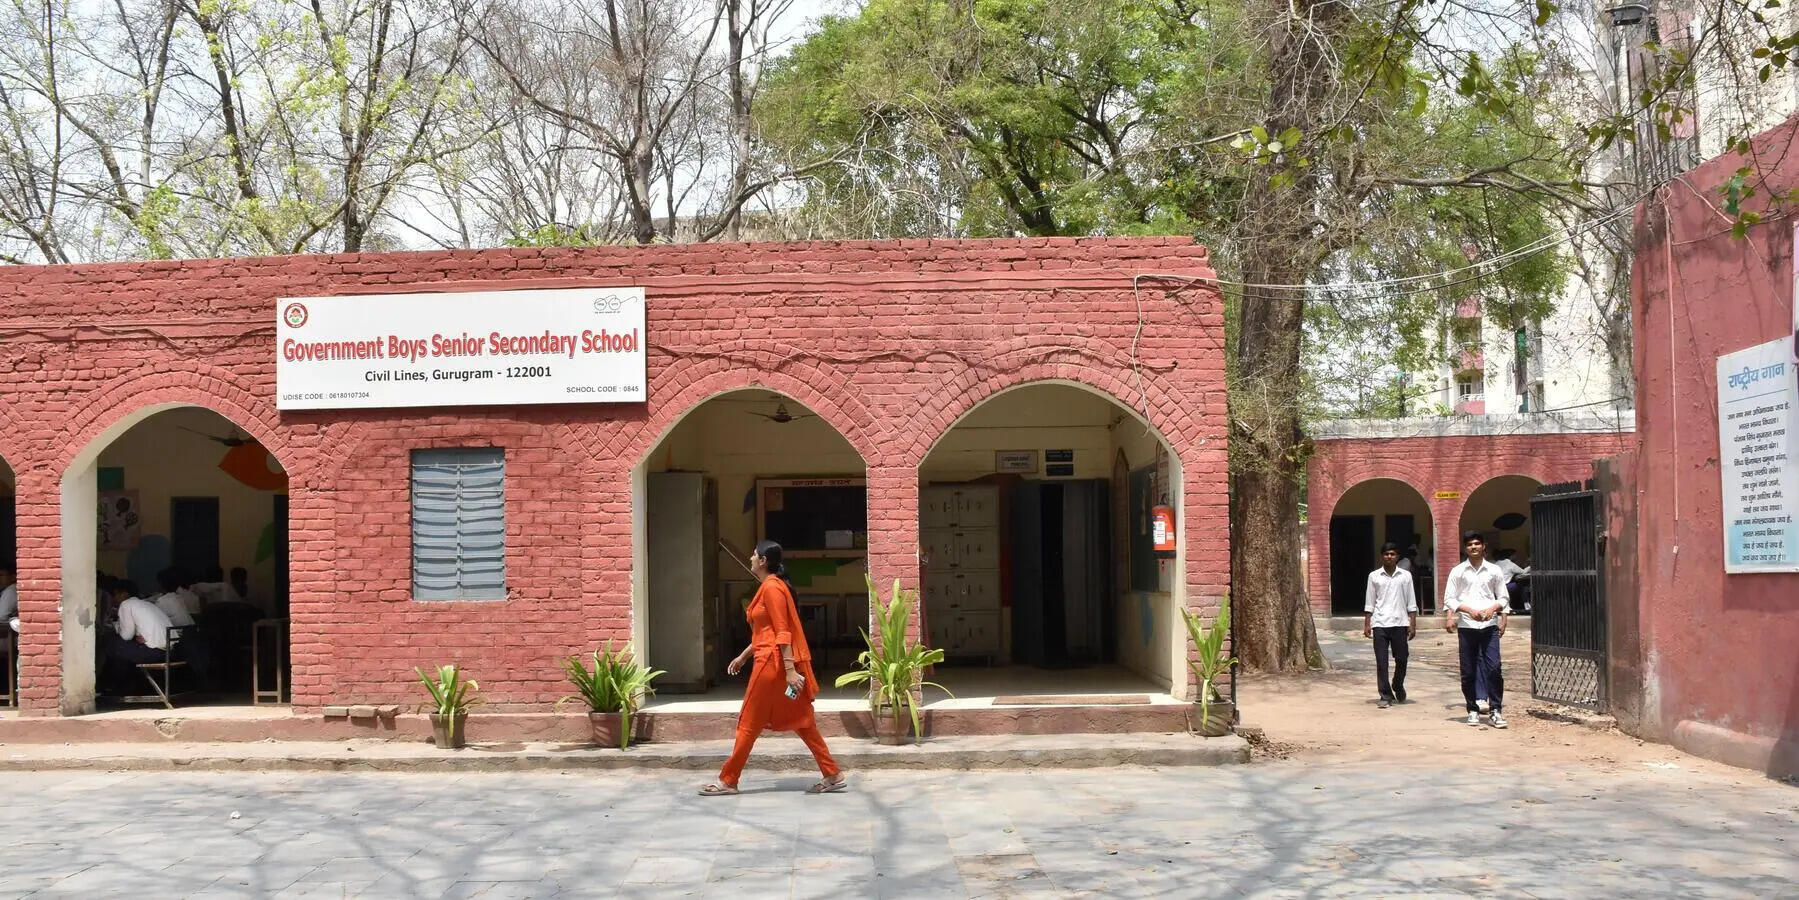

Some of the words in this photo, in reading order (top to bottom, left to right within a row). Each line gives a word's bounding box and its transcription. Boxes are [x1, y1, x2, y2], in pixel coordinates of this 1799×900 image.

[283, 336, 384, 362] Government
[388, 335, 427, 363] Boys
[431, 332, 486, 358] Senior
[489, 330, 578, 359] Secondary
[582, 328, 639, 354] School
[365, 371, 390, 382] Civil
[394, 370, 428, 383] Lines,
[432, 368, 494, 382] Gurugram
[506, 366, 552, 378] 122001
[1728, 366, 1759, 390] राष्ट्रीय
[1760, 363, 1784, 379] गान
